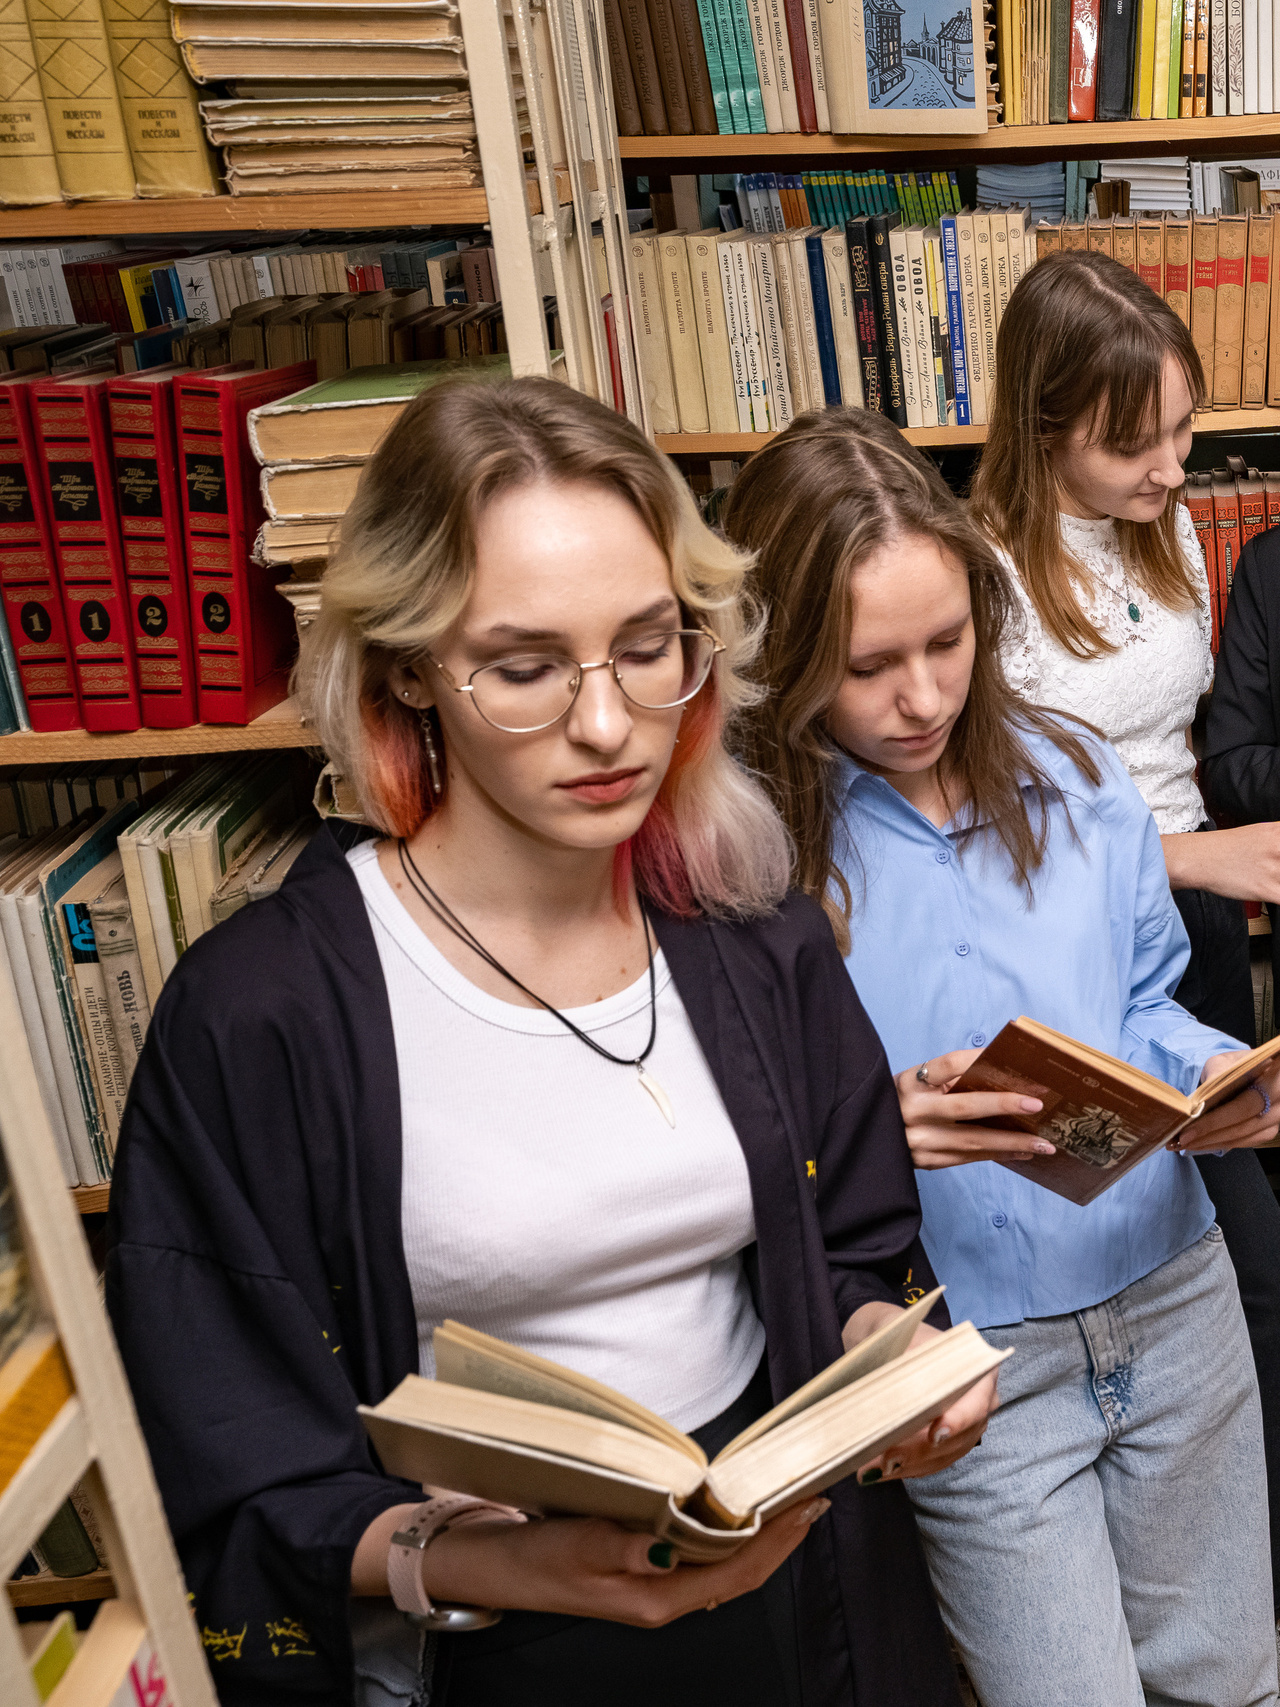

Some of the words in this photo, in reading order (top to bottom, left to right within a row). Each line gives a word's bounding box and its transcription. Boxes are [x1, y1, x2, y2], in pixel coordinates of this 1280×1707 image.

[705, 20, 716, 53] ДЖОРДЖ
[720, 18, 731, 50] ДЖОРДЖ
[738, 17, 749, 50] ДЖОРДЖ
[753, 15, 764, 45] ГОРДОН
[774, 21, 783, 51] ГОРДОН
[811, 20, 820, 50] ГОРДОН
[760, 50, 771, 86] ДЖОРДЖ
[779, 55, 790, 91] ДЖОРДЖ
[815, 54, 826, 91] ДЖОРДЖ
[62, 110, 102, 119] ПОВЕСТИ
[138, 110, 177, 119] ПОВЕСТИ
[66, 130, 105, 139] РАССКАЗЫ
[142, 129, 180, 138] РАССКАЗЫ
[671, 272, 680, 296] БРОНТЕ
[760, 252, 774, 305] Моцарта
[879, 262, 889, 290] оперы
[893, 253, 906, 293] ОВОД
[911, 257, 924, 296] ОВОД
[964, 254, 973, 287] ЛОРКА
[981, 257, 989, 288] ЛОРКА
[999, 256, 1007, 287] ЛОРКА
[642, 300, 651, 334] ШАРЛОТТА
[676, 299, 685, 334] ШАРЛОТТА
[704, 299, 713, 333] ШАРЛОТТА
[882, 291, 893, 325] Роман
[967, 291, 978, 329] ГАРСИА
[983, 292, 993, 329] ГАРСИА
[767, 306, 782, 361] Убийство
[885, 326, 896, 352] Верди
[970, 332, 981, 382] ФЕДЕРИКО
[986, 331, 996, 379] ФЕДЕРИКО
[773, 369, 787, 392] Вейс
[889, 357, 900, 397] Верфель
[776, 391, 790, 423] Дэвид
[892, 397, 901, 408] Ф.
[959, 404, 965, 418] 1
[29, 612, 44, 632] 1
[88, 612, 102, 632] 1
[145, 607, 162, 626] 2
[208, 604, 225, 623] 2
[84, 987, 98, 1012] ДЕТИ
[117, 969, 138, 1015] НОВЬ
[92, 1021, 105, 1045] ОТЦЫ
[104, 1020, 117, 1052] КОРОЛЬ
[98, 1051, 115, 1097] НАКАНУНЕ
[110, 1056, 127, 1097] СТЕПНОЙ
